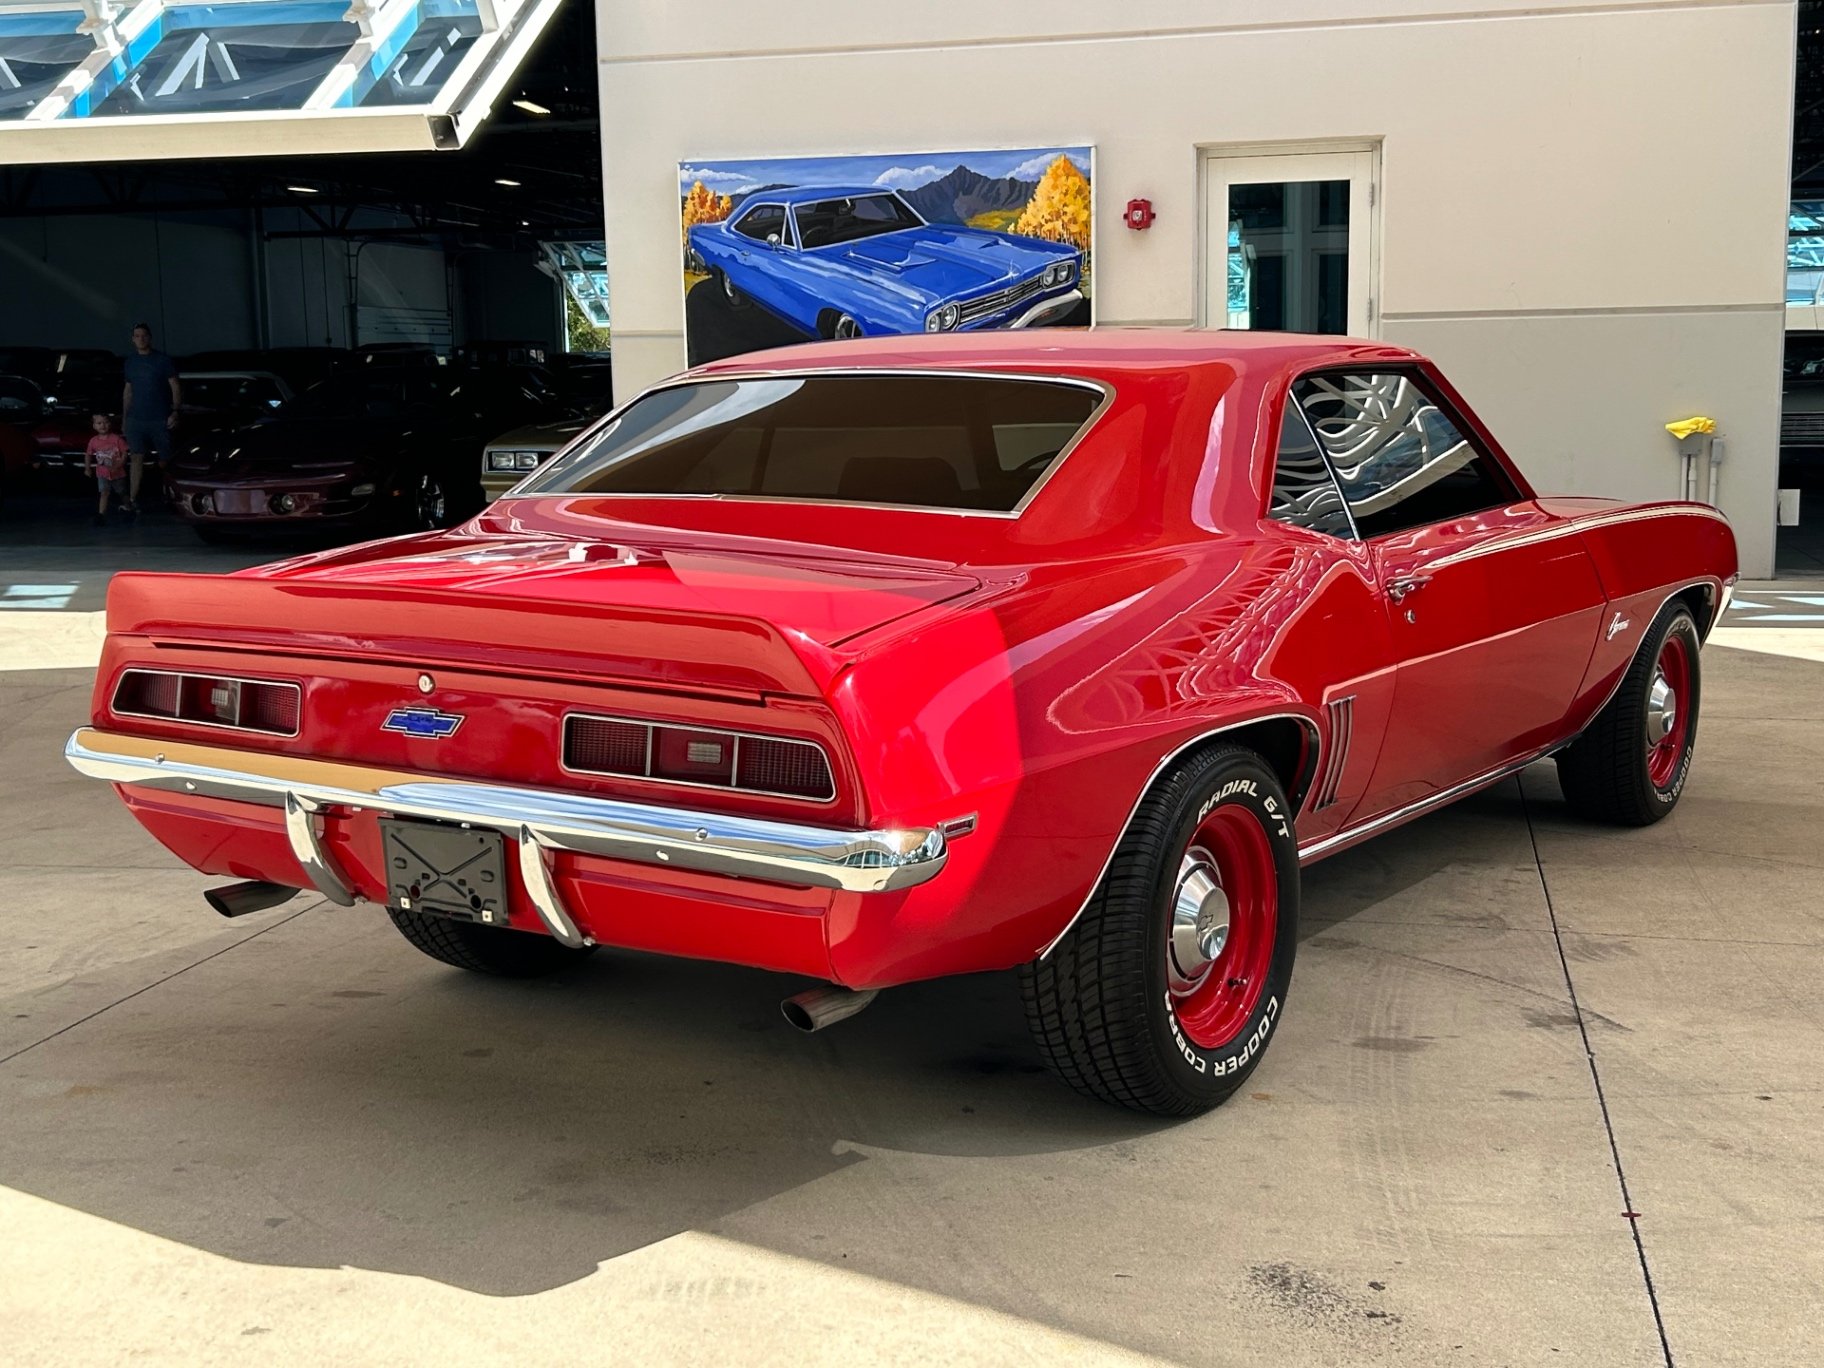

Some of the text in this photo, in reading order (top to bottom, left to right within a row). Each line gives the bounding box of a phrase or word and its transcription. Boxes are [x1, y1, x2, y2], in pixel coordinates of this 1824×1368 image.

[1671, 745, 1693, 797] COOPER
[1197, 779, 1290, 838] RADIAL G/T
[1213, 995, 1279, 1077] COOPER
